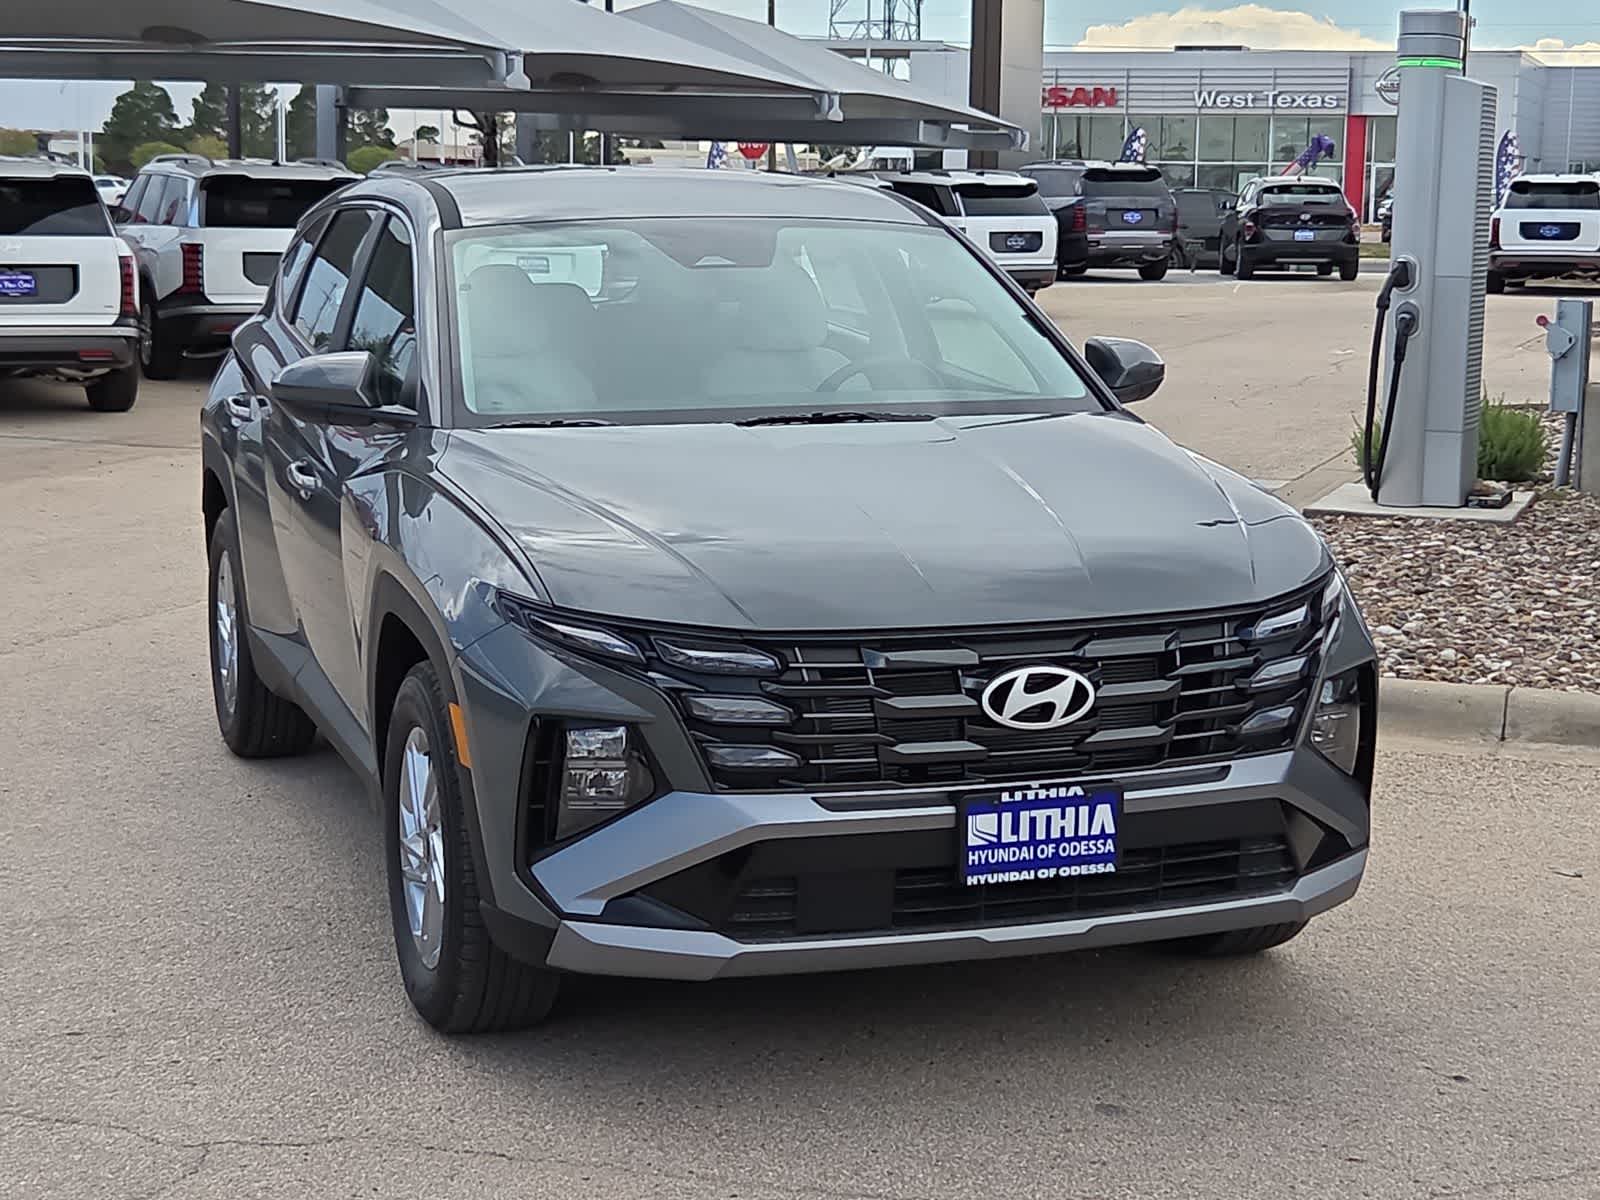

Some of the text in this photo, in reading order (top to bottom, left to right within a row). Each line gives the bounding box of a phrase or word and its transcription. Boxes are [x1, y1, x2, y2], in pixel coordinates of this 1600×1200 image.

[1042, 87, 1117, 107] SAN
[1194, 90, 1338, 108] West Texas
[1001, 786, 1084, 802] LITHIA
[1001, 804, 1116, 843] LITHIA
[968, 838, 1115, 866] HYUNDAI OF ODESSA
[967, 862, 1116, 886] HYUNDAI OF ODESSA
